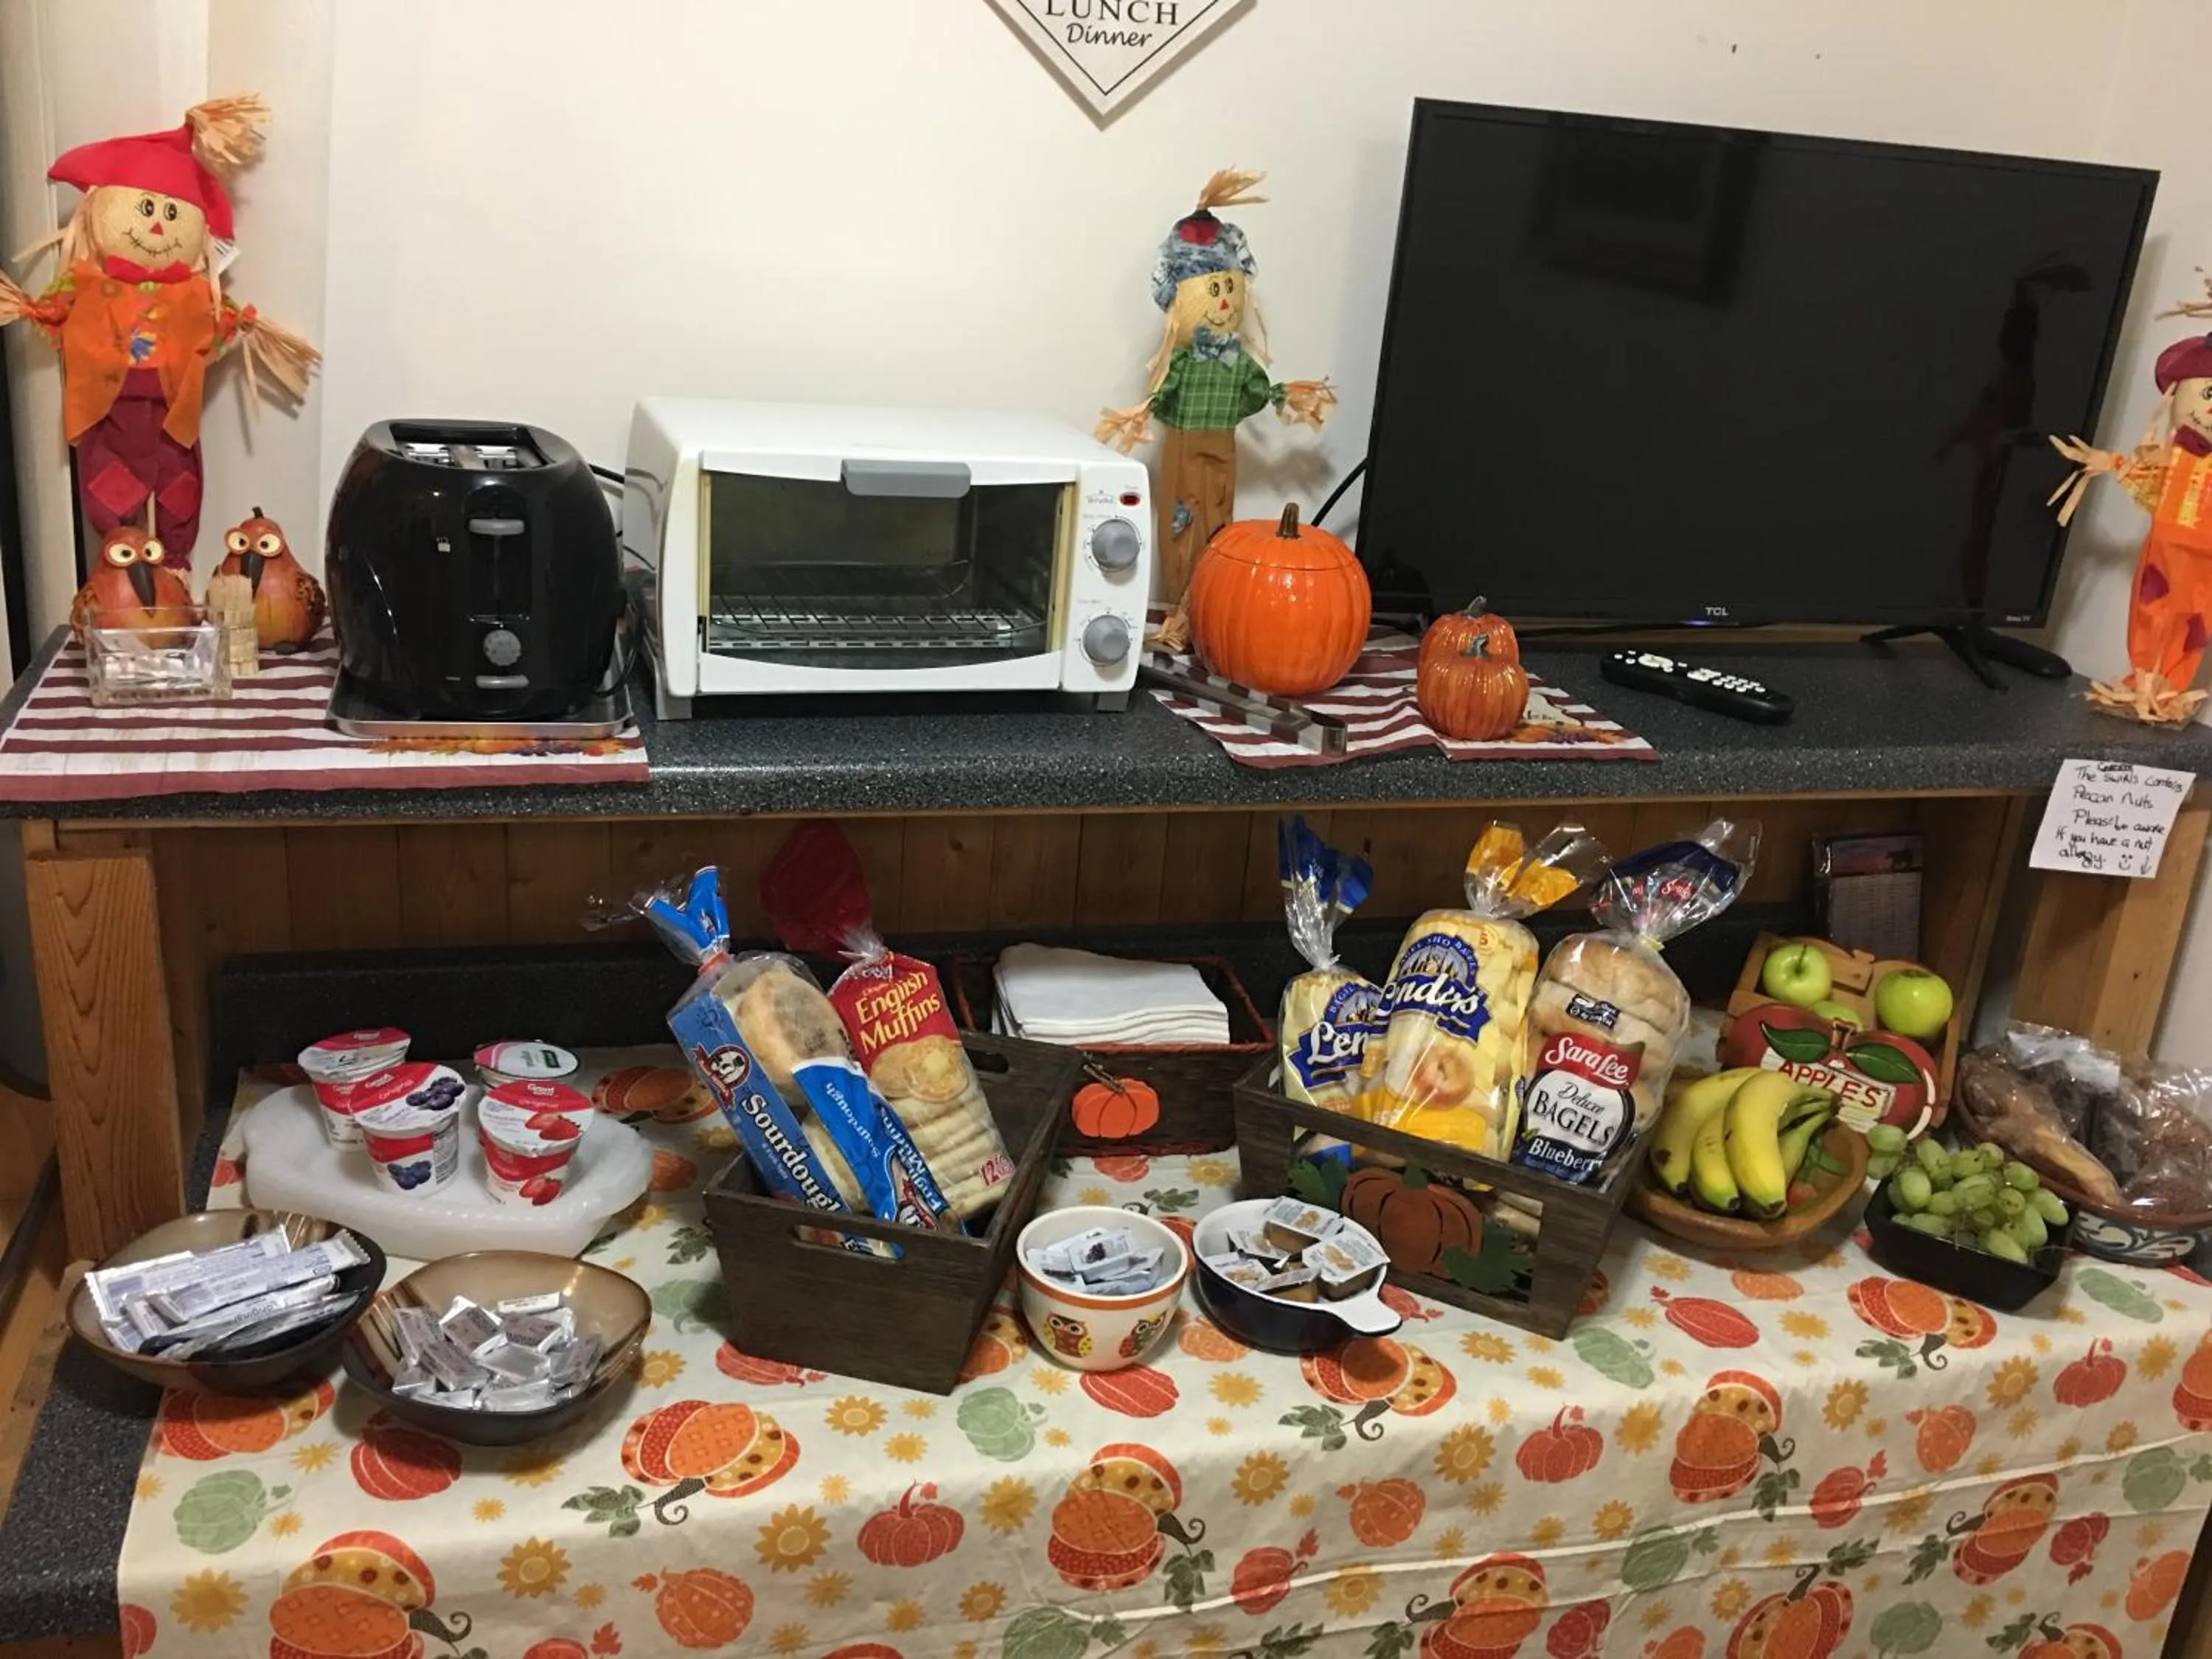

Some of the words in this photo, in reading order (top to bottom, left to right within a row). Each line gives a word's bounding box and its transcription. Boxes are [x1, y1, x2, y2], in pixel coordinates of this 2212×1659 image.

[1045, 0, 1180, 26] LUNCH
[1066, 22, 1153, 48] Dinner
[1704, 607, 1730, 617] TCL
[2076, 765, 2096, 782] The
[855, 971, 929, 1025] English
[859, 993, 941, 1055] Muffins
[1545, 1037, 1601, 1071] Sara
[1595, 1052, 1630, 1086] Lee
[1778, 1061, 1882, 1108] APPLES
[825, 1082, 881, 1158] Sourdough
[1533, 1089, 1615, 1147] BAGELS
[1557, 1081, 1606, 1115] Deluxe
